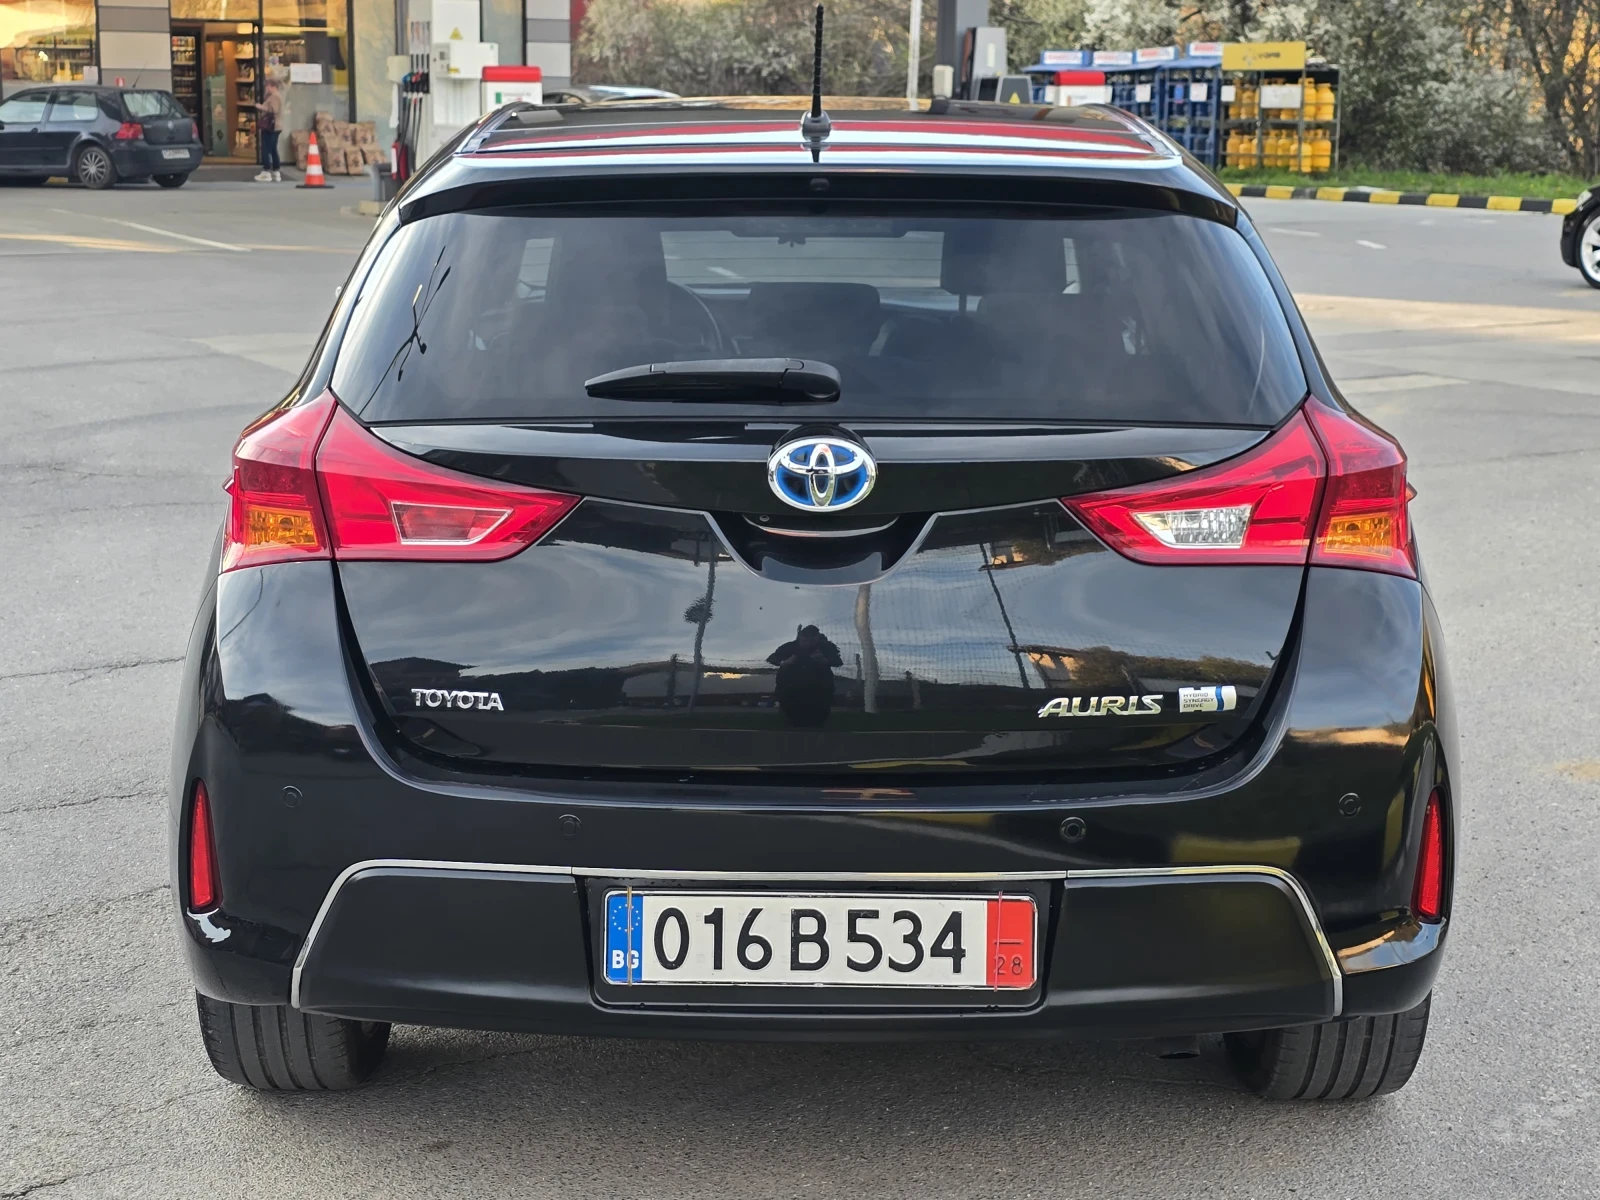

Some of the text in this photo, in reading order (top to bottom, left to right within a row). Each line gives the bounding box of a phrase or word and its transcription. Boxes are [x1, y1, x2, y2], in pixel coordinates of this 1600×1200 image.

[411, 688, 505, 711] TOYOTA
[1037, 694, 1164, 718] AURIS
[612, 949, 640, 969] BG
[994, 954, 1023, 976] 28
